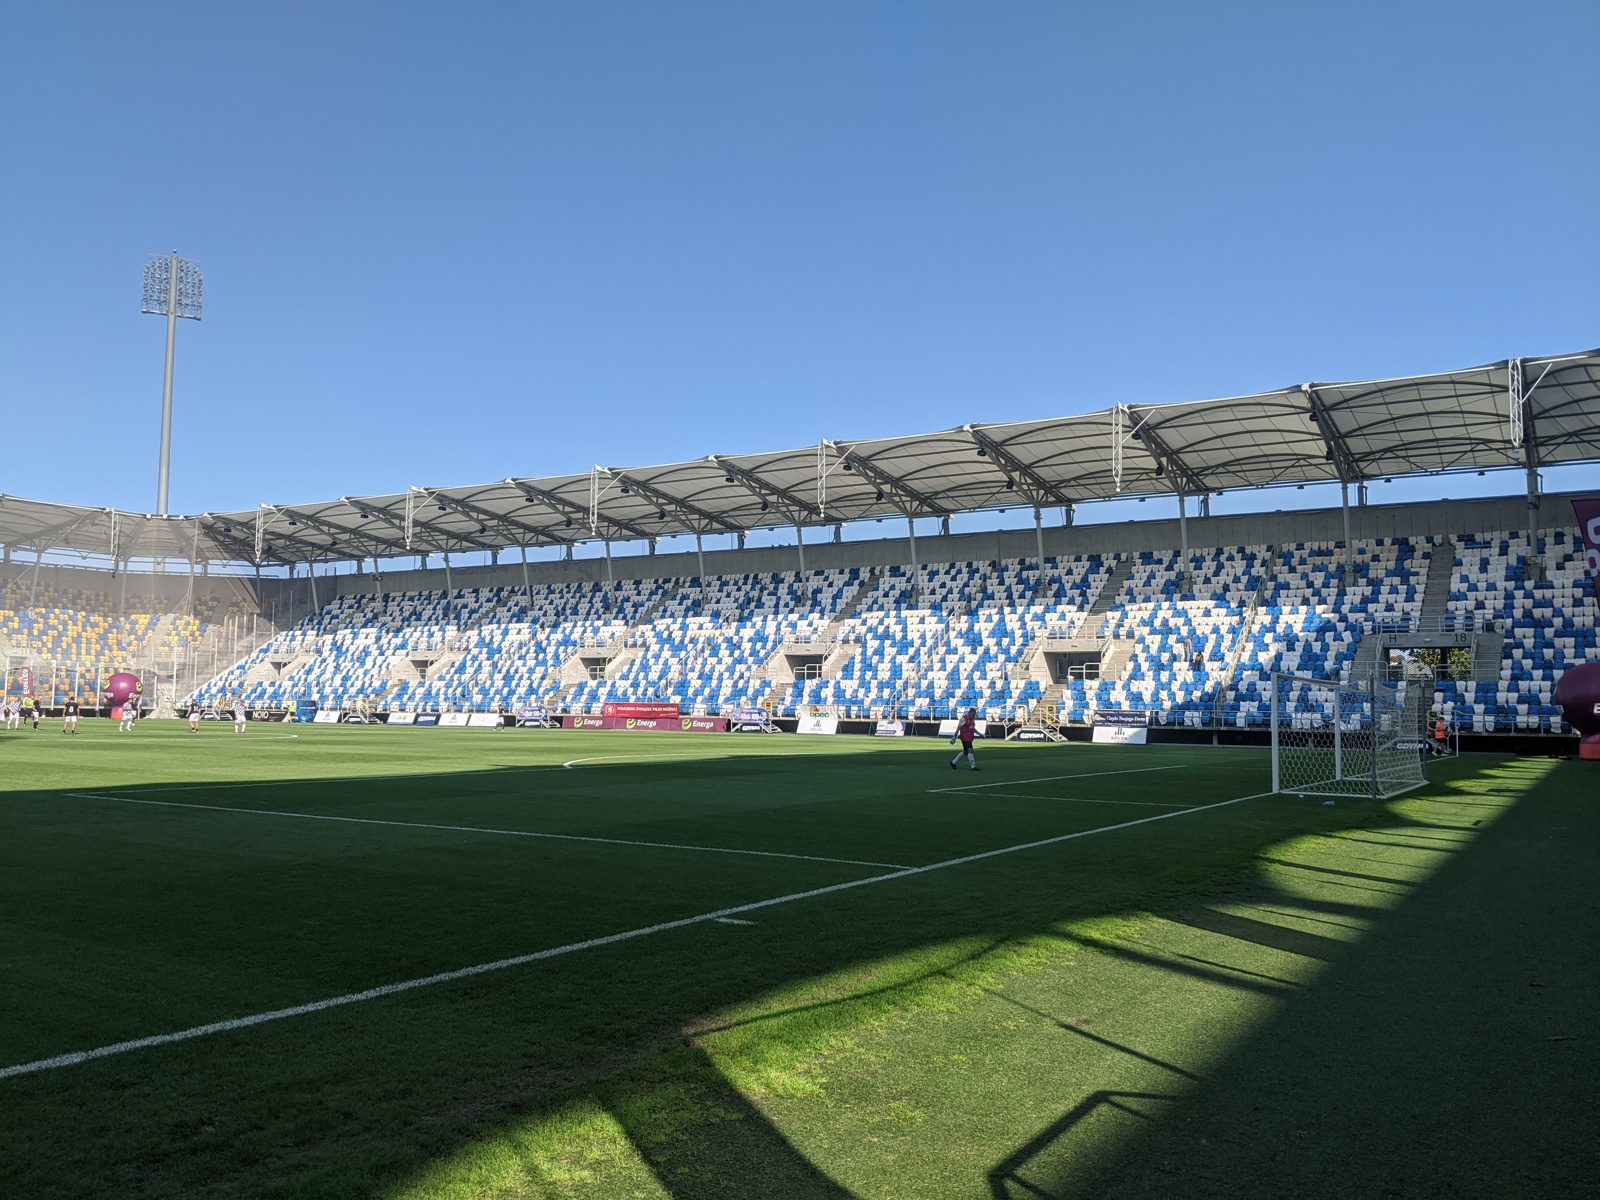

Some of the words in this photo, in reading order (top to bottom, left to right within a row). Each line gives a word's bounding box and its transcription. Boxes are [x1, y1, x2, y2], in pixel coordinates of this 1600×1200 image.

[1389, 634, 1397, 643] H
[1454, 632, 1466, 642] 18
[69, 705, 75, 713] 8
[584, 718, 603, 727] Energa
[636, 720, 656, 728] Energa
[692, 720, 714, 729] Energa
